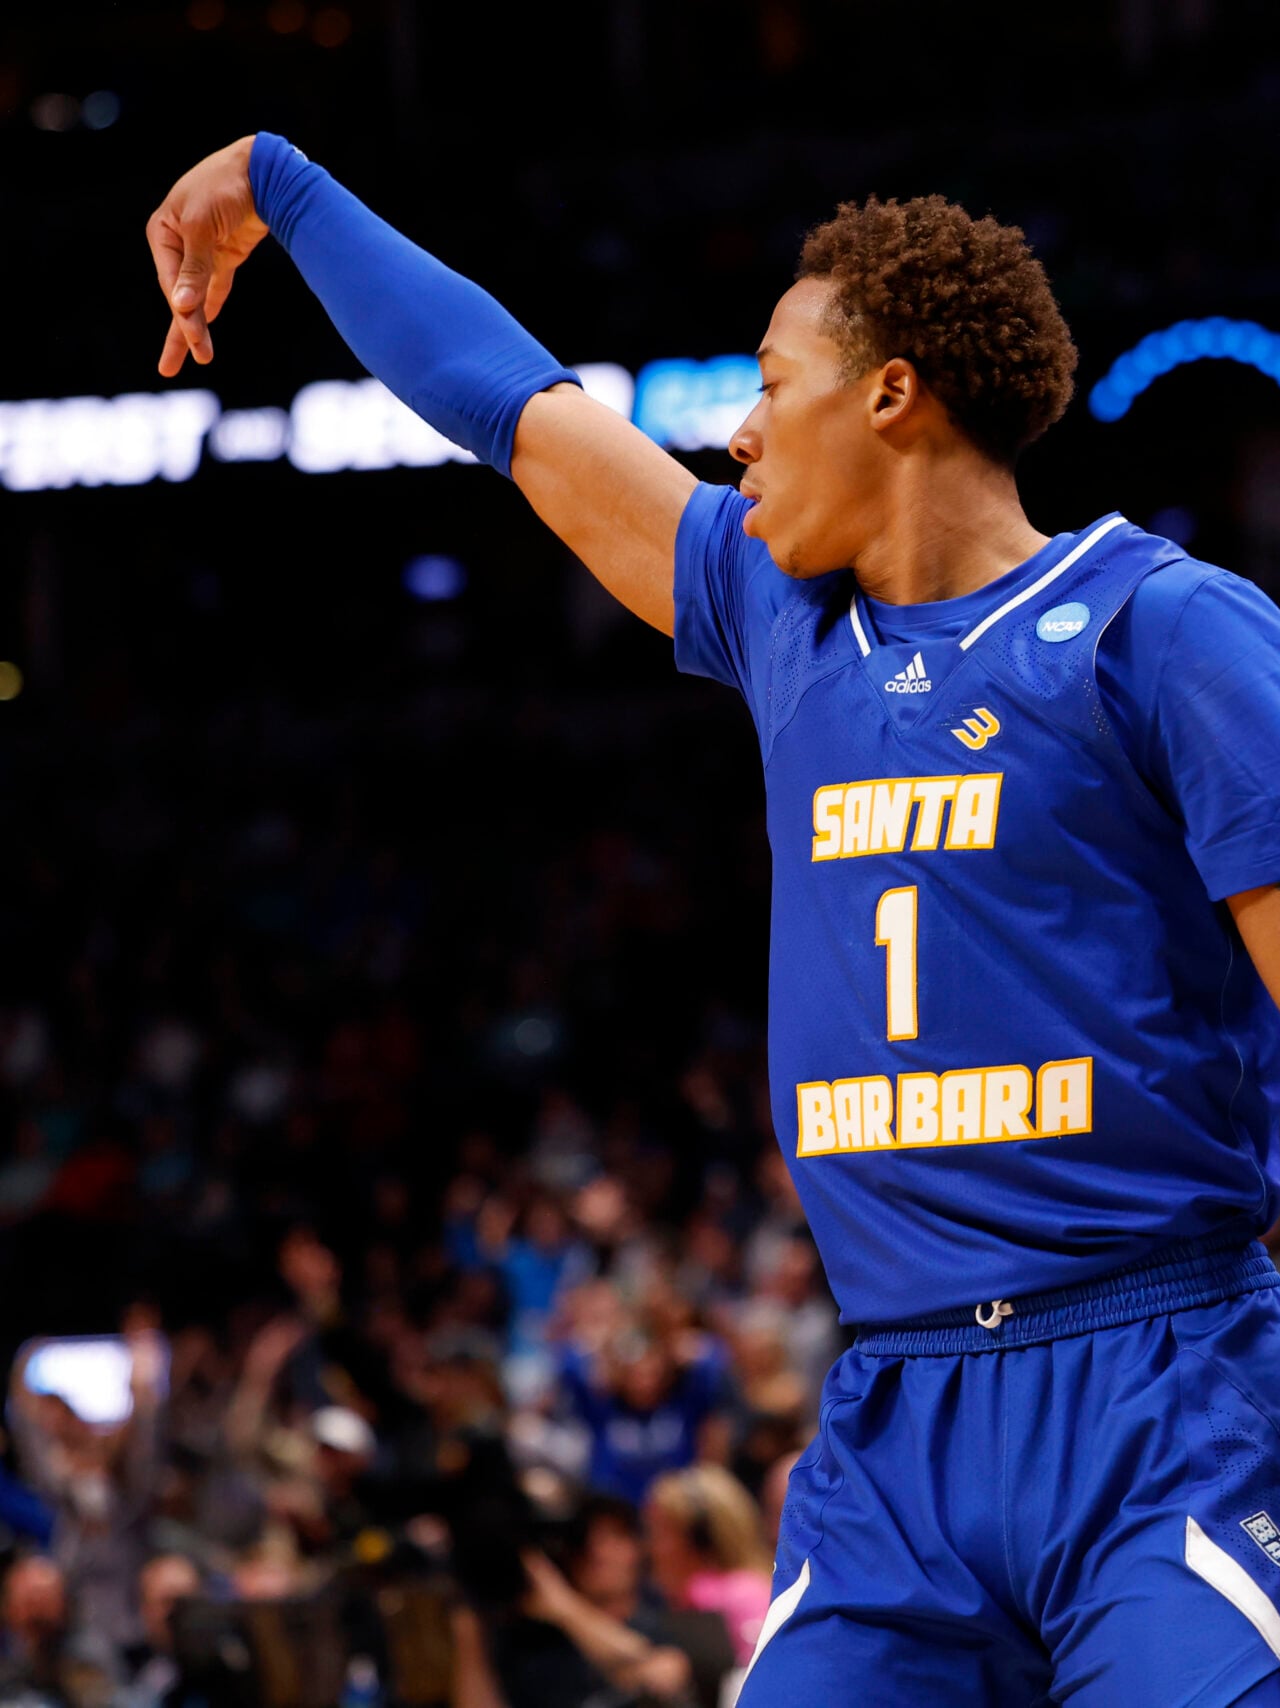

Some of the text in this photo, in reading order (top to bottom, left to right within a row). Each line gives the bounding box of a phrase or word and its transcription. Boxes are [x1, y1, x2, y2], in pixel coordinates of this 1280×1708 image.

[1041, 620, 1084, 632] NCAA
[884, 678, 932, 694] adidas
[811, 772, 1003, 862] SANTA
[875, 885, 918, 1041] 1
[796, 1056, 1093, 1158] BARBARA
